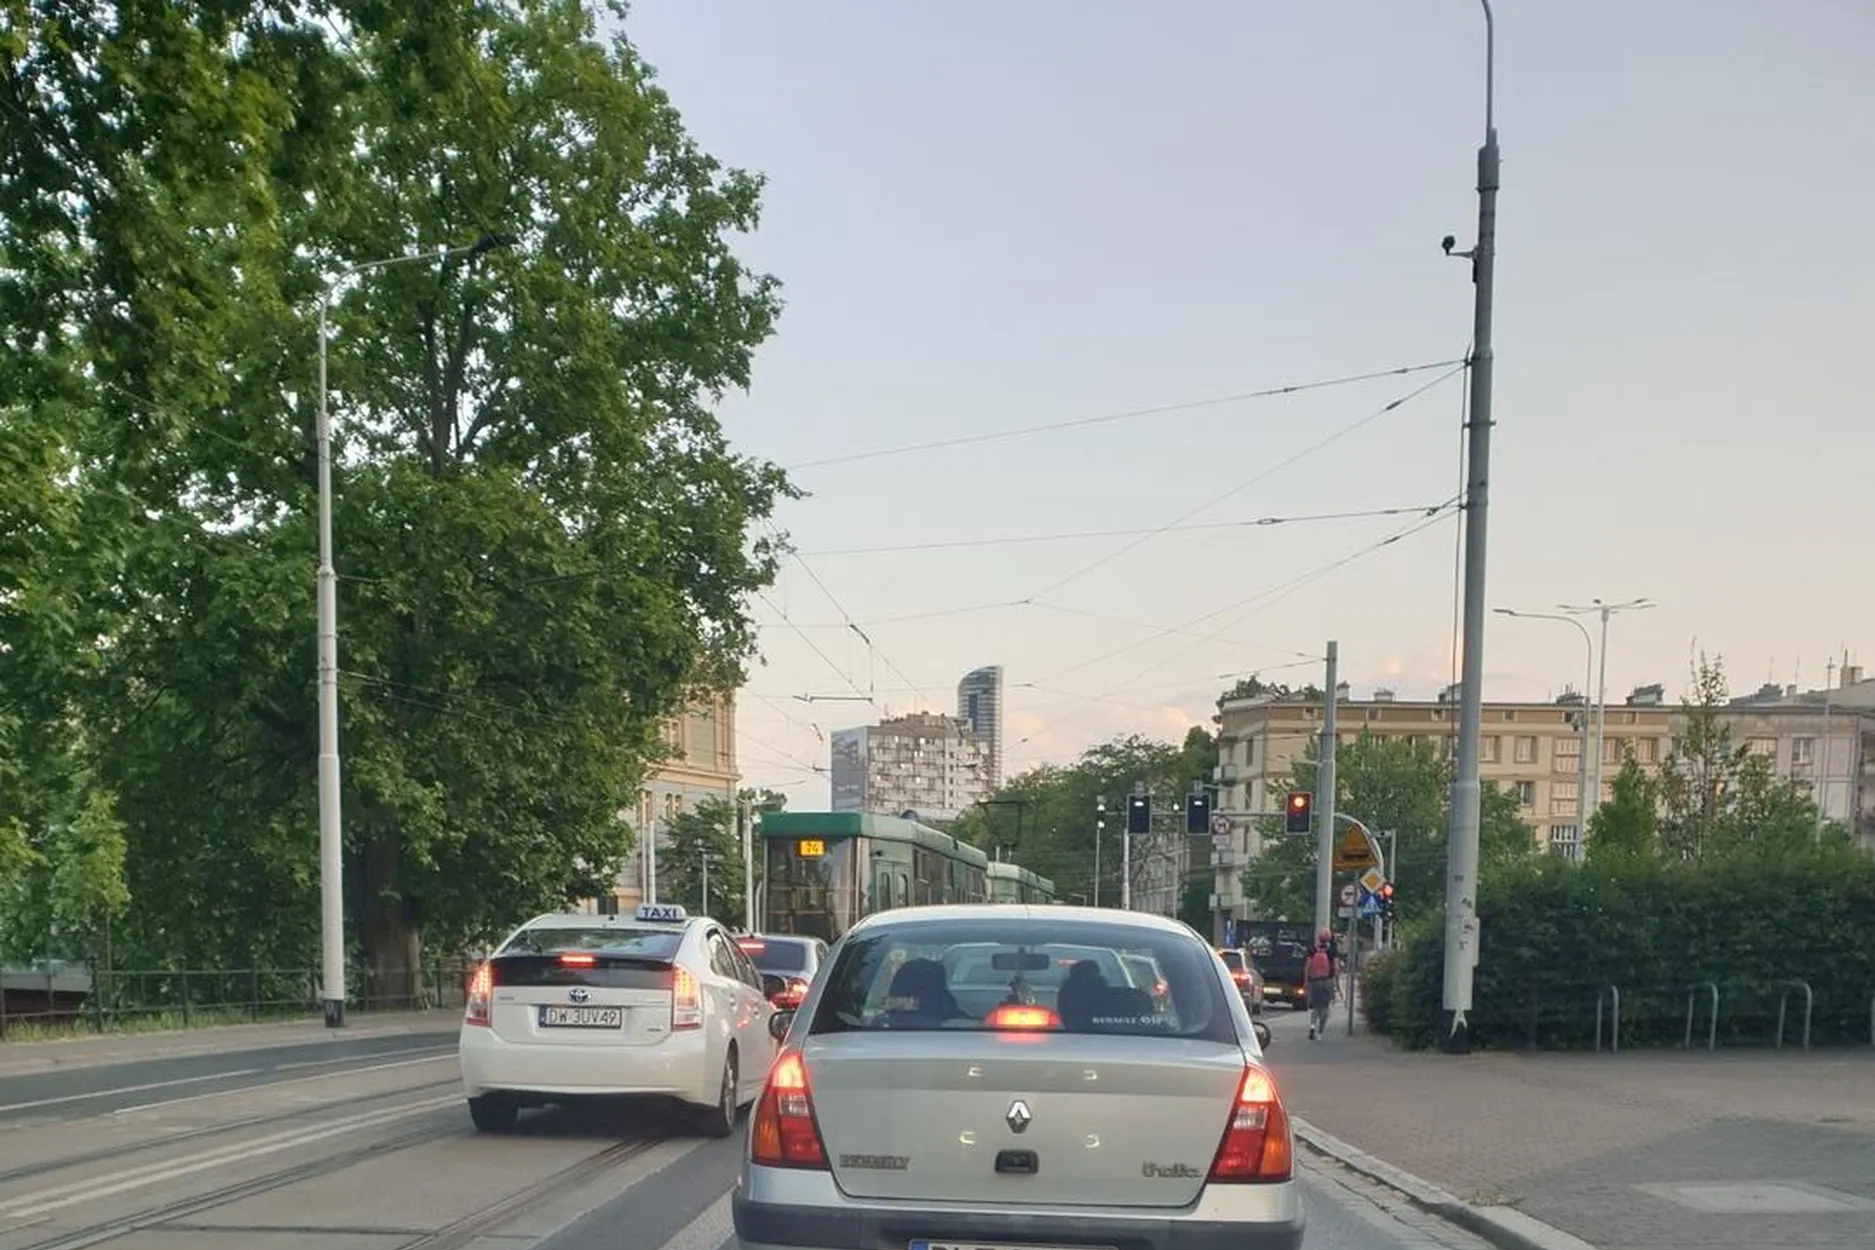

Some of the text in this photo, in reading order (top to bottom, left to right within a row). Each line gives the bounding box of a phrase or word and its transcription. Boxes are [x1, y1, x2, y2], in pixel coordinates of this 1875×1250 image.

[642, 907, 677, 919] TAXI
[549, 1009, 617, 1024] DW 3UV49
